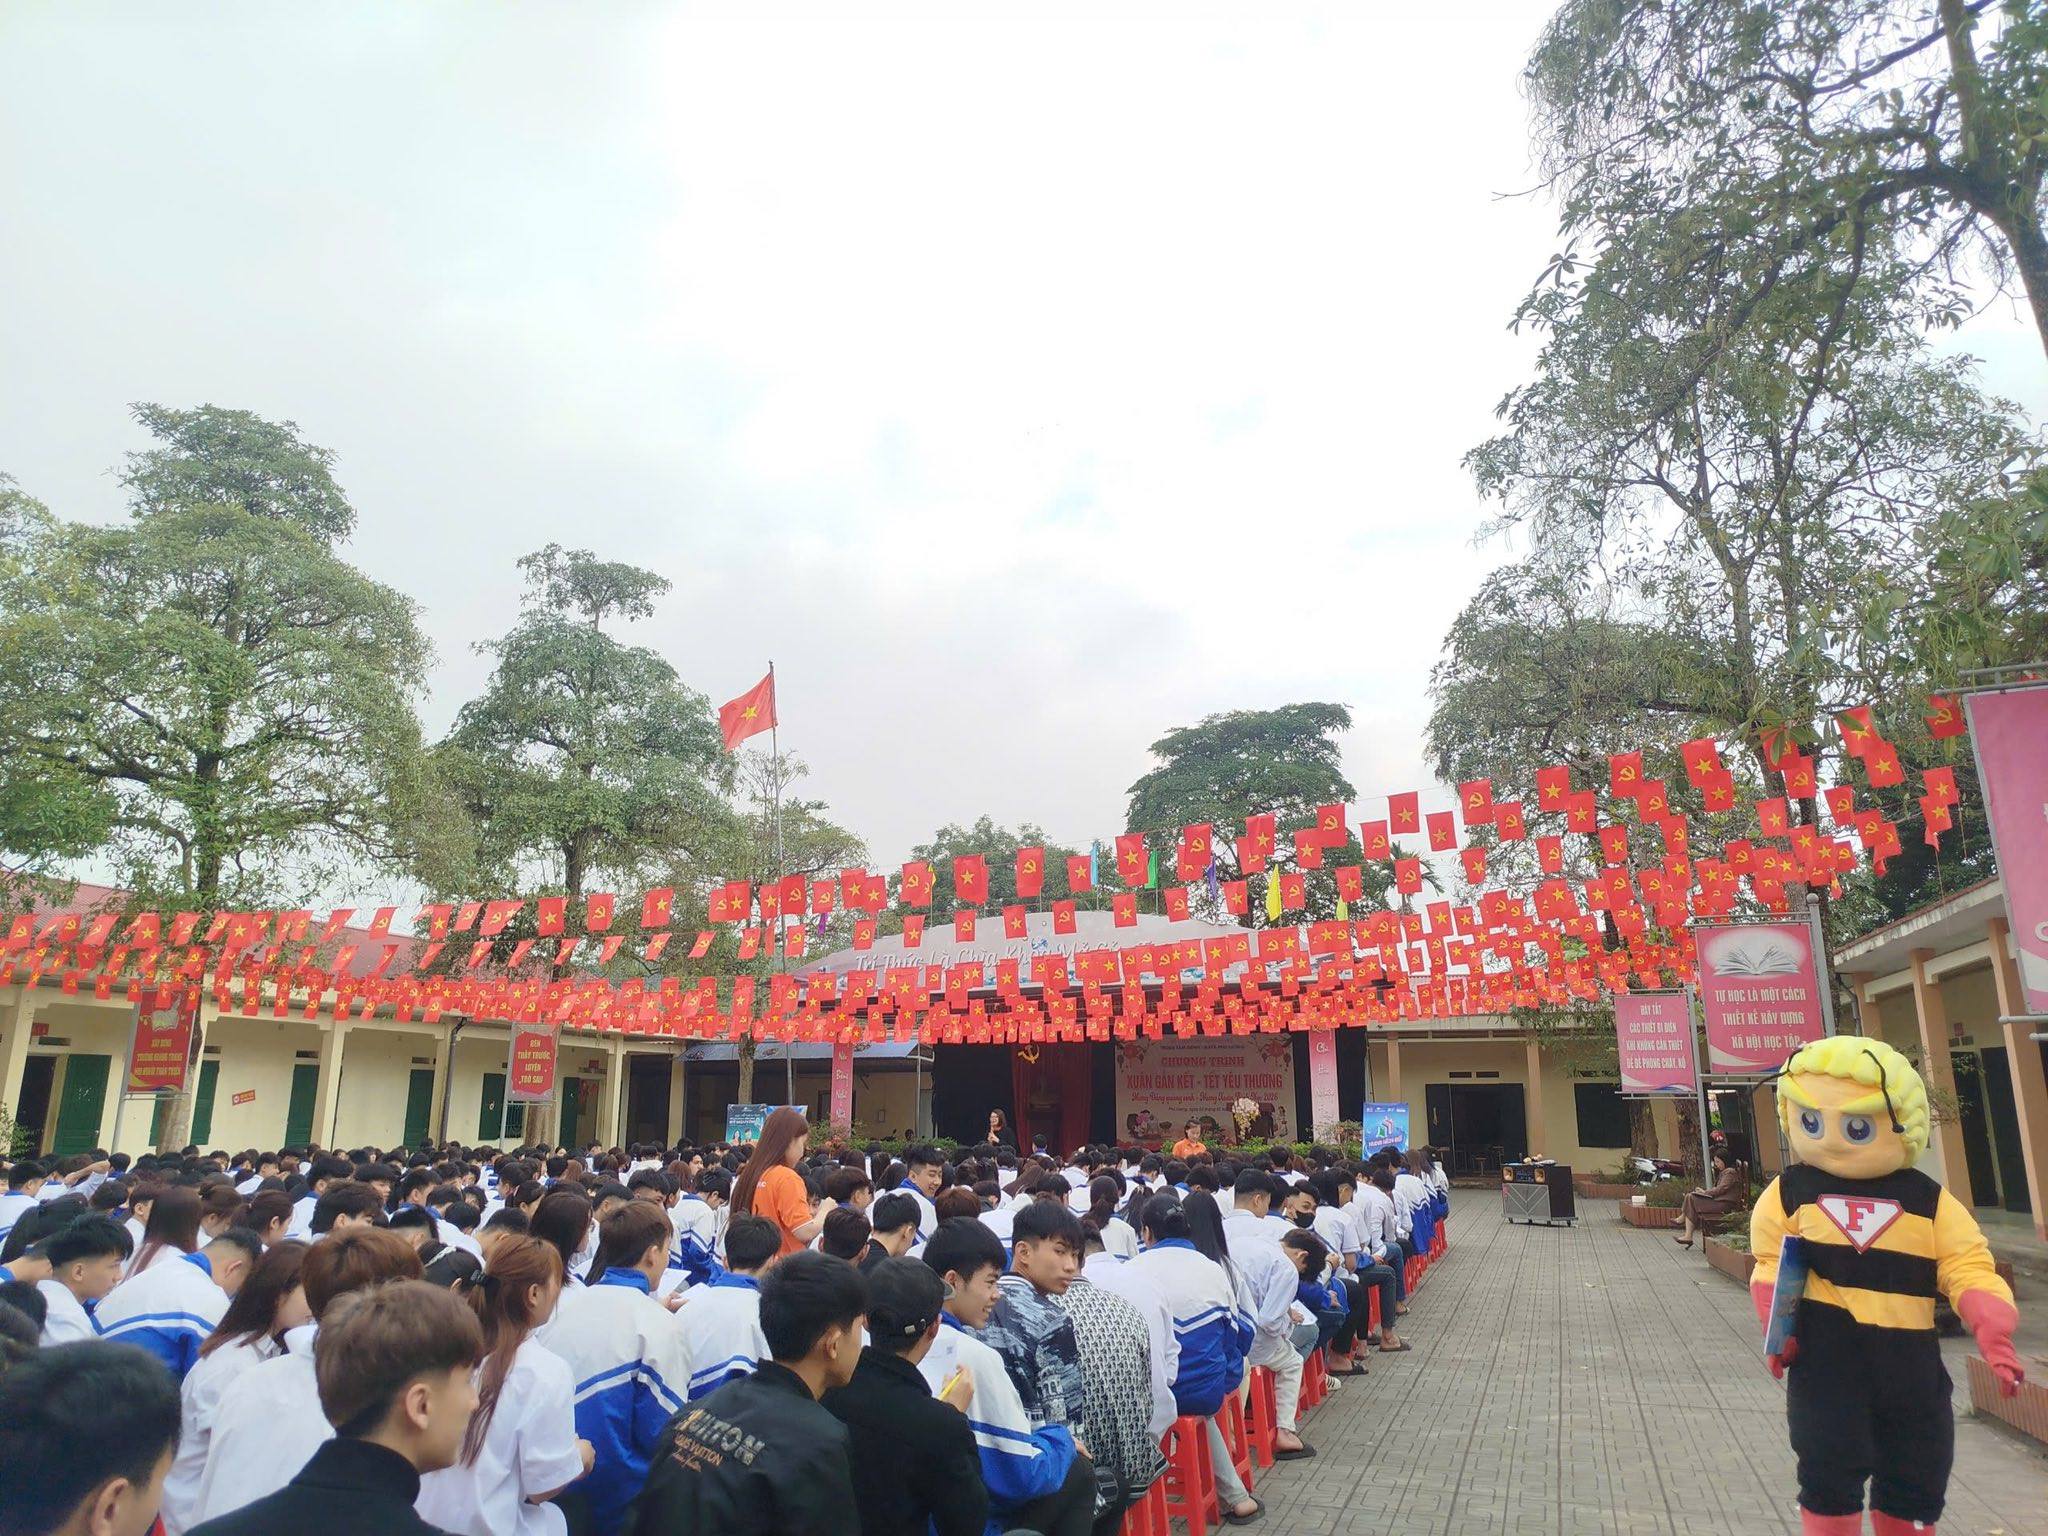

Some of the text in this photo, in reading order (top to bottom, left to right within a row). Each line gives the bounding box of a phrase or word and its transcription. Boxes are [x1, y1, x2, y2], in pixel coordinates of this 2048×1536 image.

[1715, 986, 1806, 1005] TỰ HỌC LÀ MỘT CÁCH
[1722, 1008, 1746, 1026] THIẾT
[1780, 1011, 1805, 1027] DỰNG
[1746, 1033, 1762, 1051] HỘI
[1763, 1035, 1782, 1051] HỌC
[1784, 1033, 1801, 1051] TẬP
[1845, 1200, 1875, 1232] F
